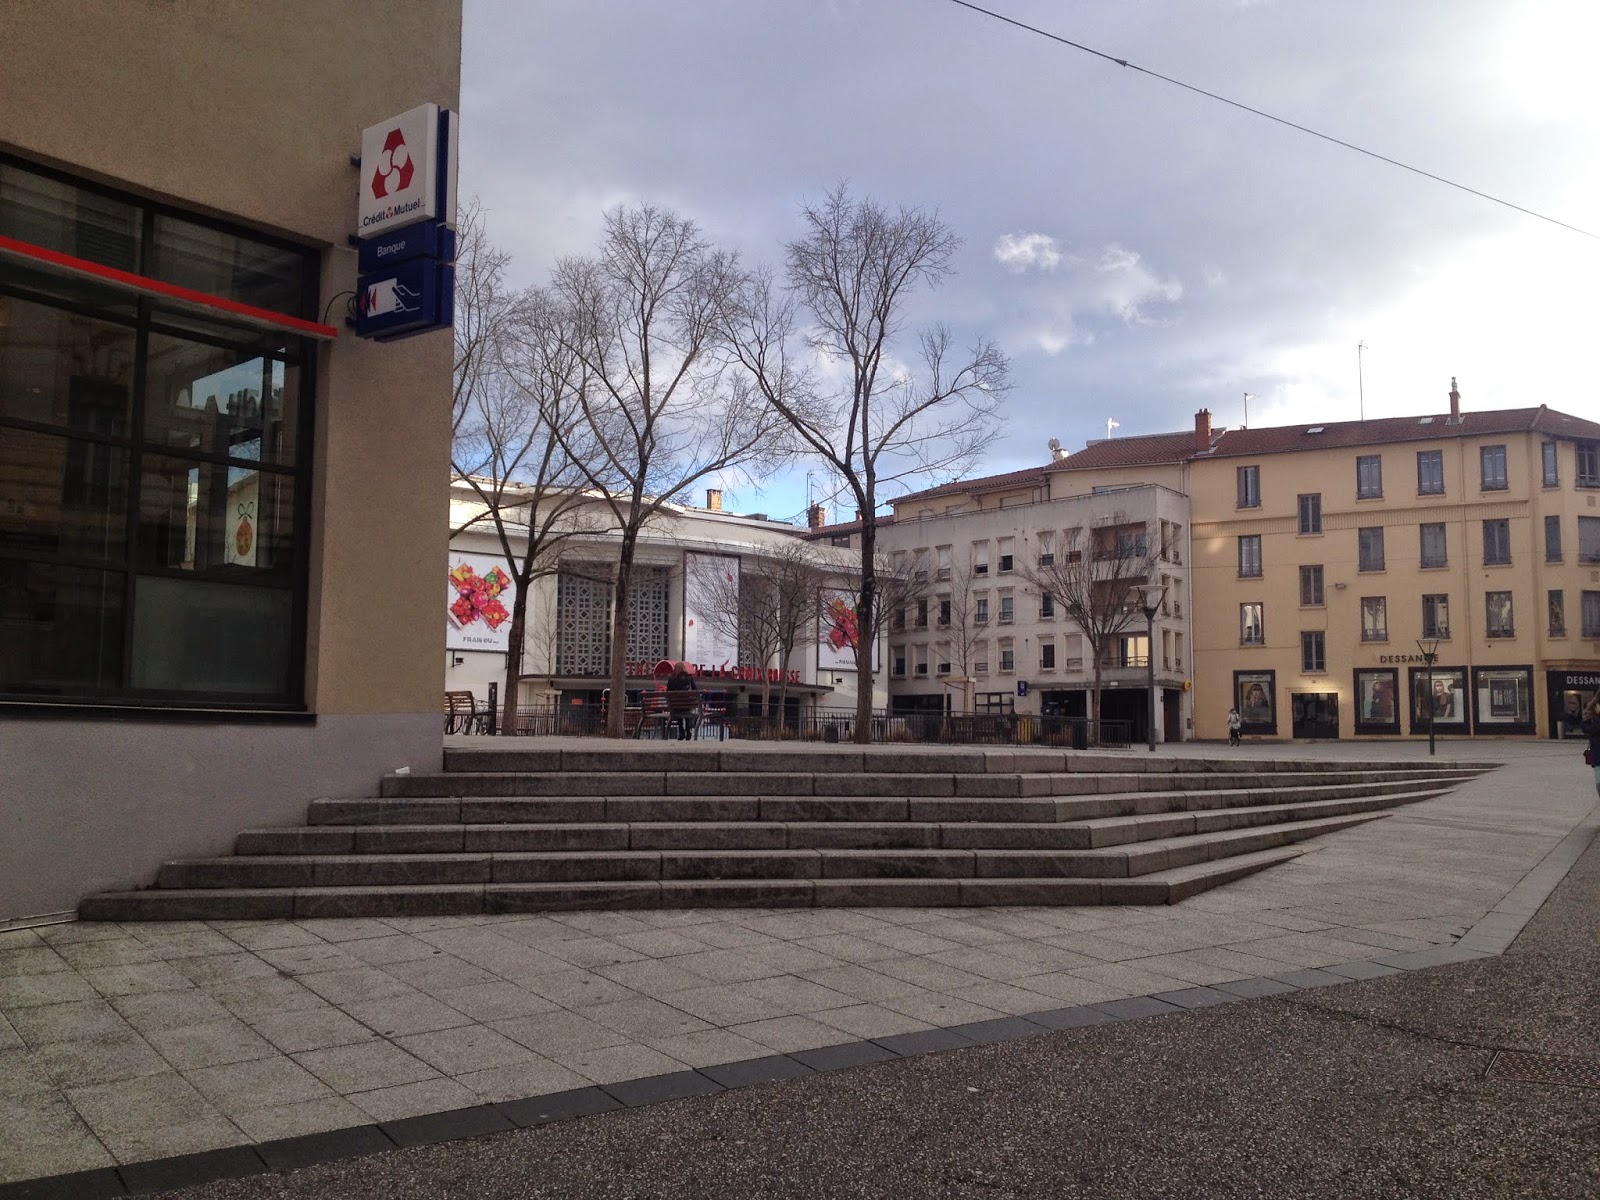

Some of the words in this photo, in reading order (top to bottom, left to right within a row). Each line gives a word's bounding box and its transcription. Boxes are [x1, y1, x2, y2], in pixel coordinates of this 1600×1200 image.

[363, 210, 386, 226] Crédit
[394, 198, 420, 216] Mutuel
[377, 241, 406, 257] Banque
[1380, 654, 1439, 663] DESSANE
